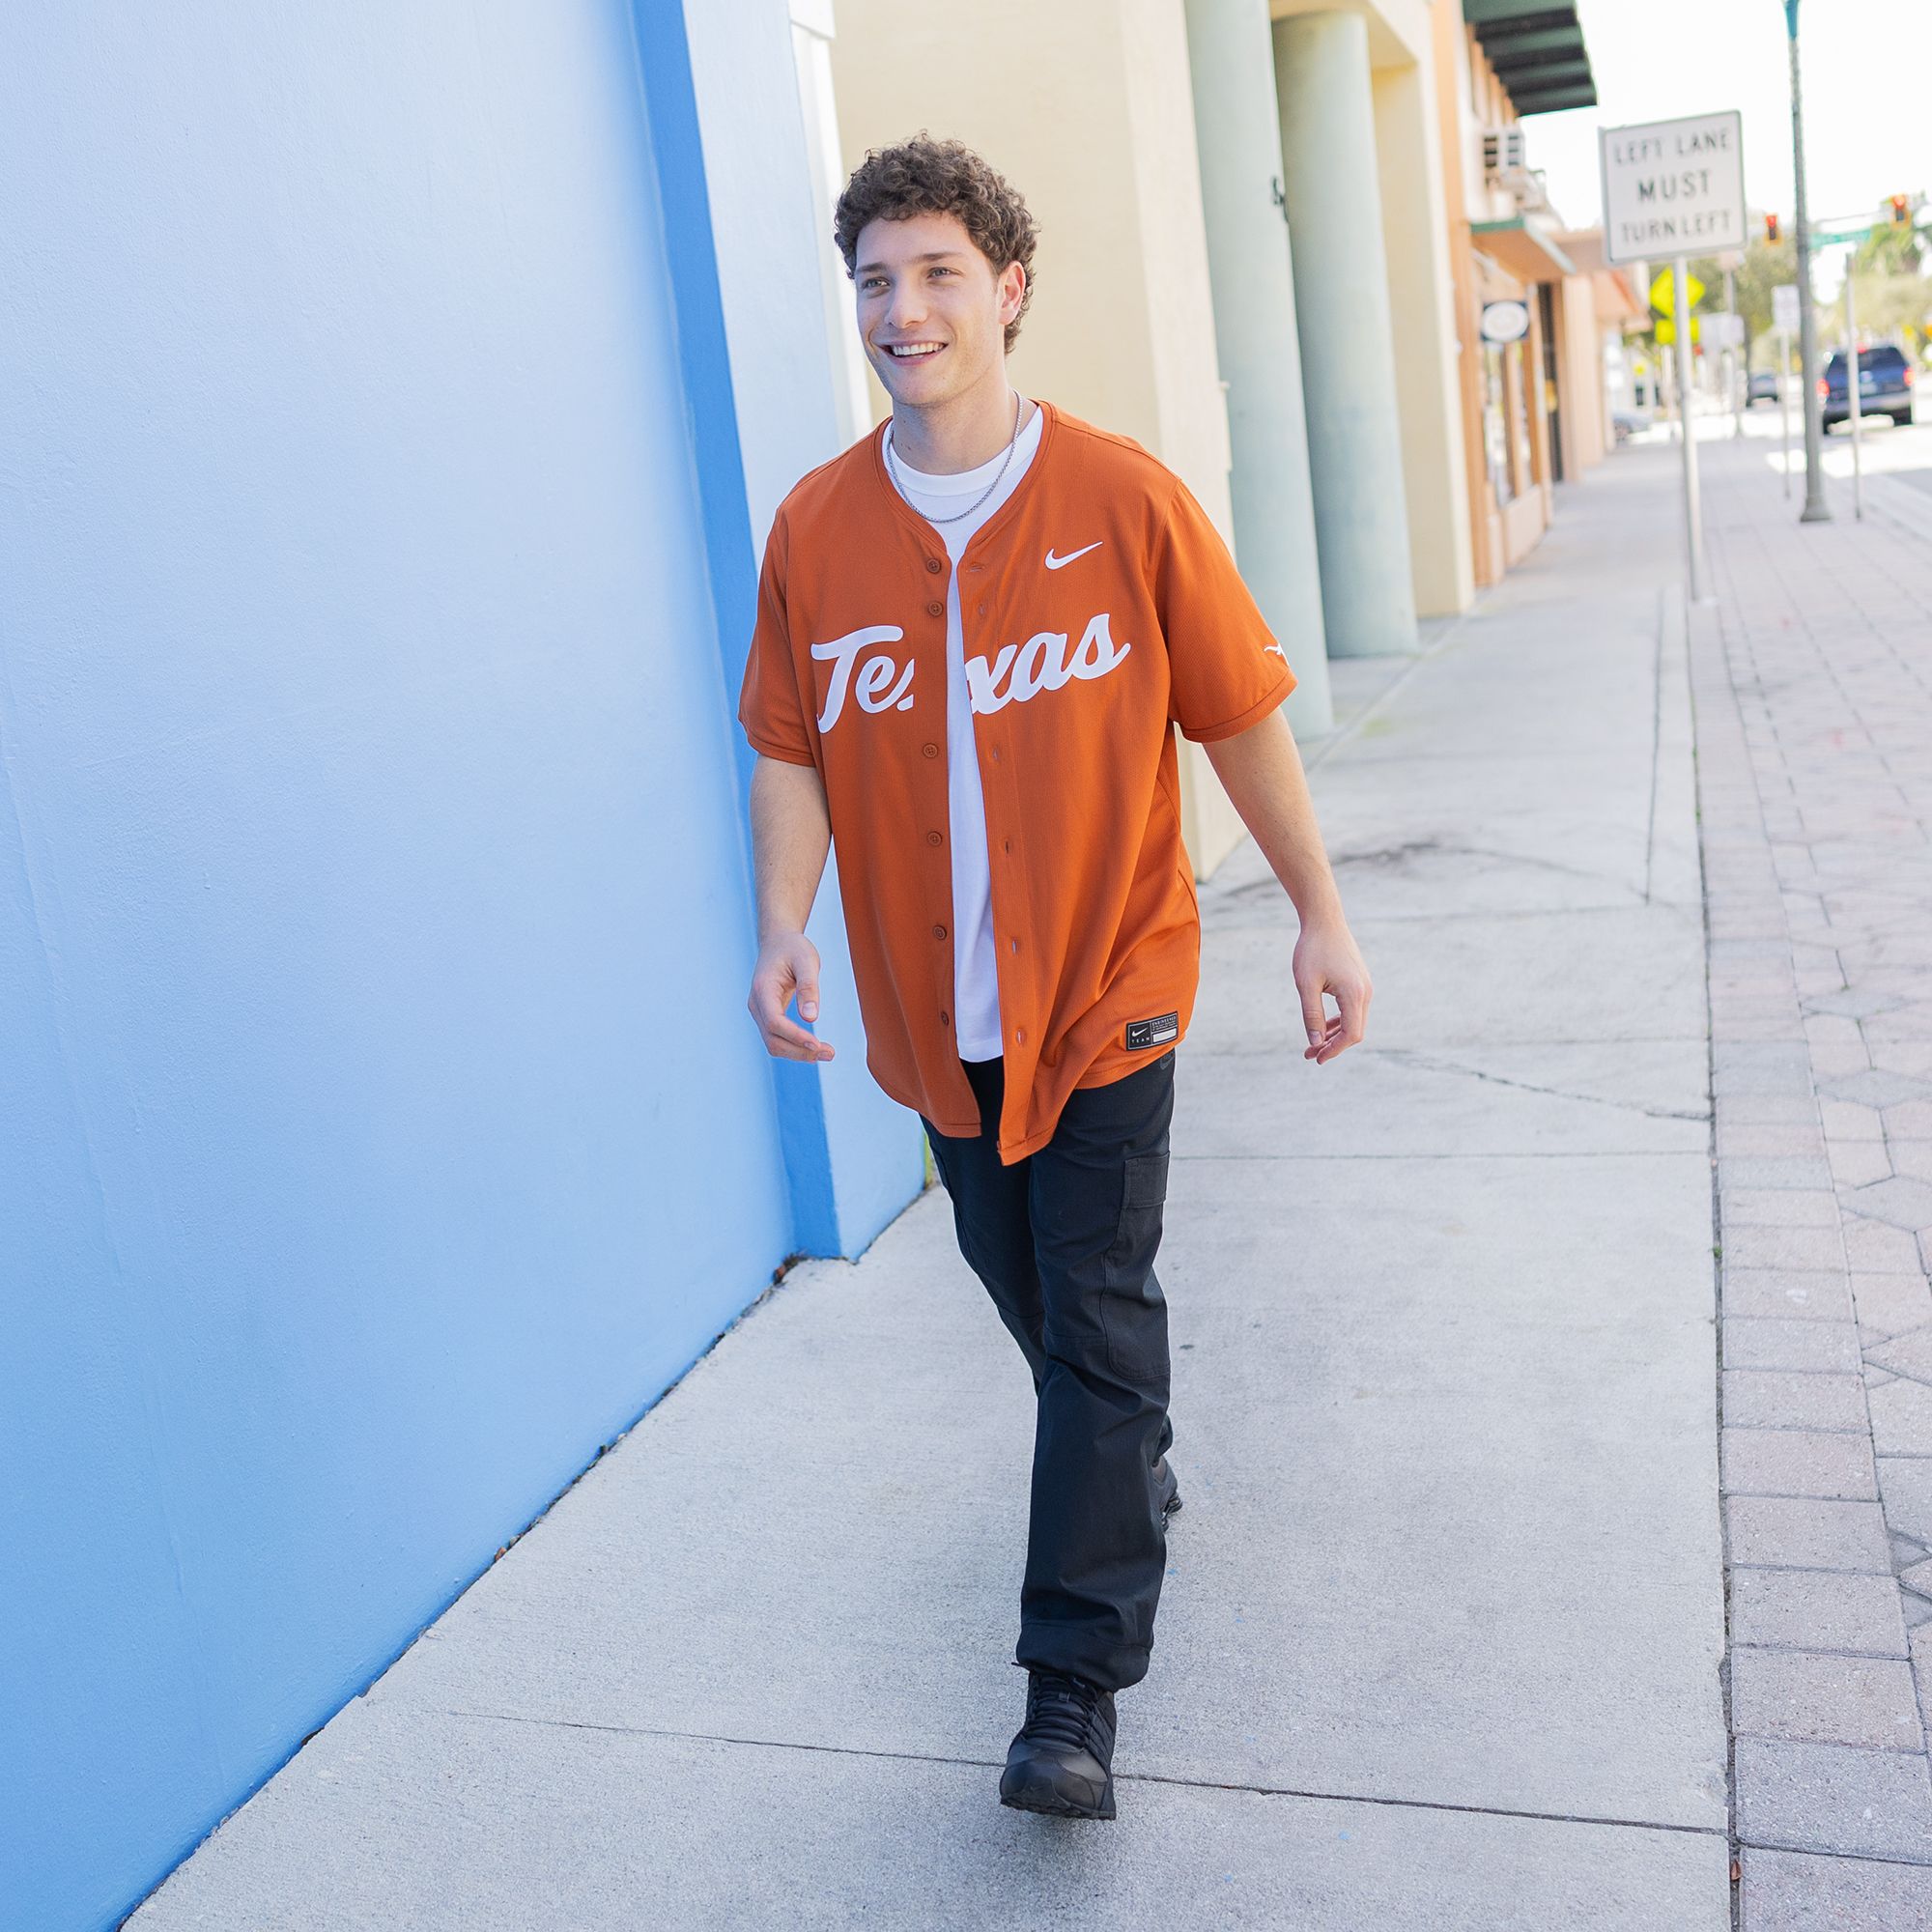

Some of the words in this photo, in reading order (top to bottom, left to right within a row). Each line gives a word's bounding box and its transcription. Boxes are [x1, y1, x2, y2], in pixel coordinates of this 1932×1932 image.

[1614, 137, 1662, 164] LEFT
[1677, 128, 1729, 156] LANE
[1637, 168, 1710, 203] MUST
[1622, 219, 1676, 242] TURN
[1682, 209, 1731, 236] LEFT
